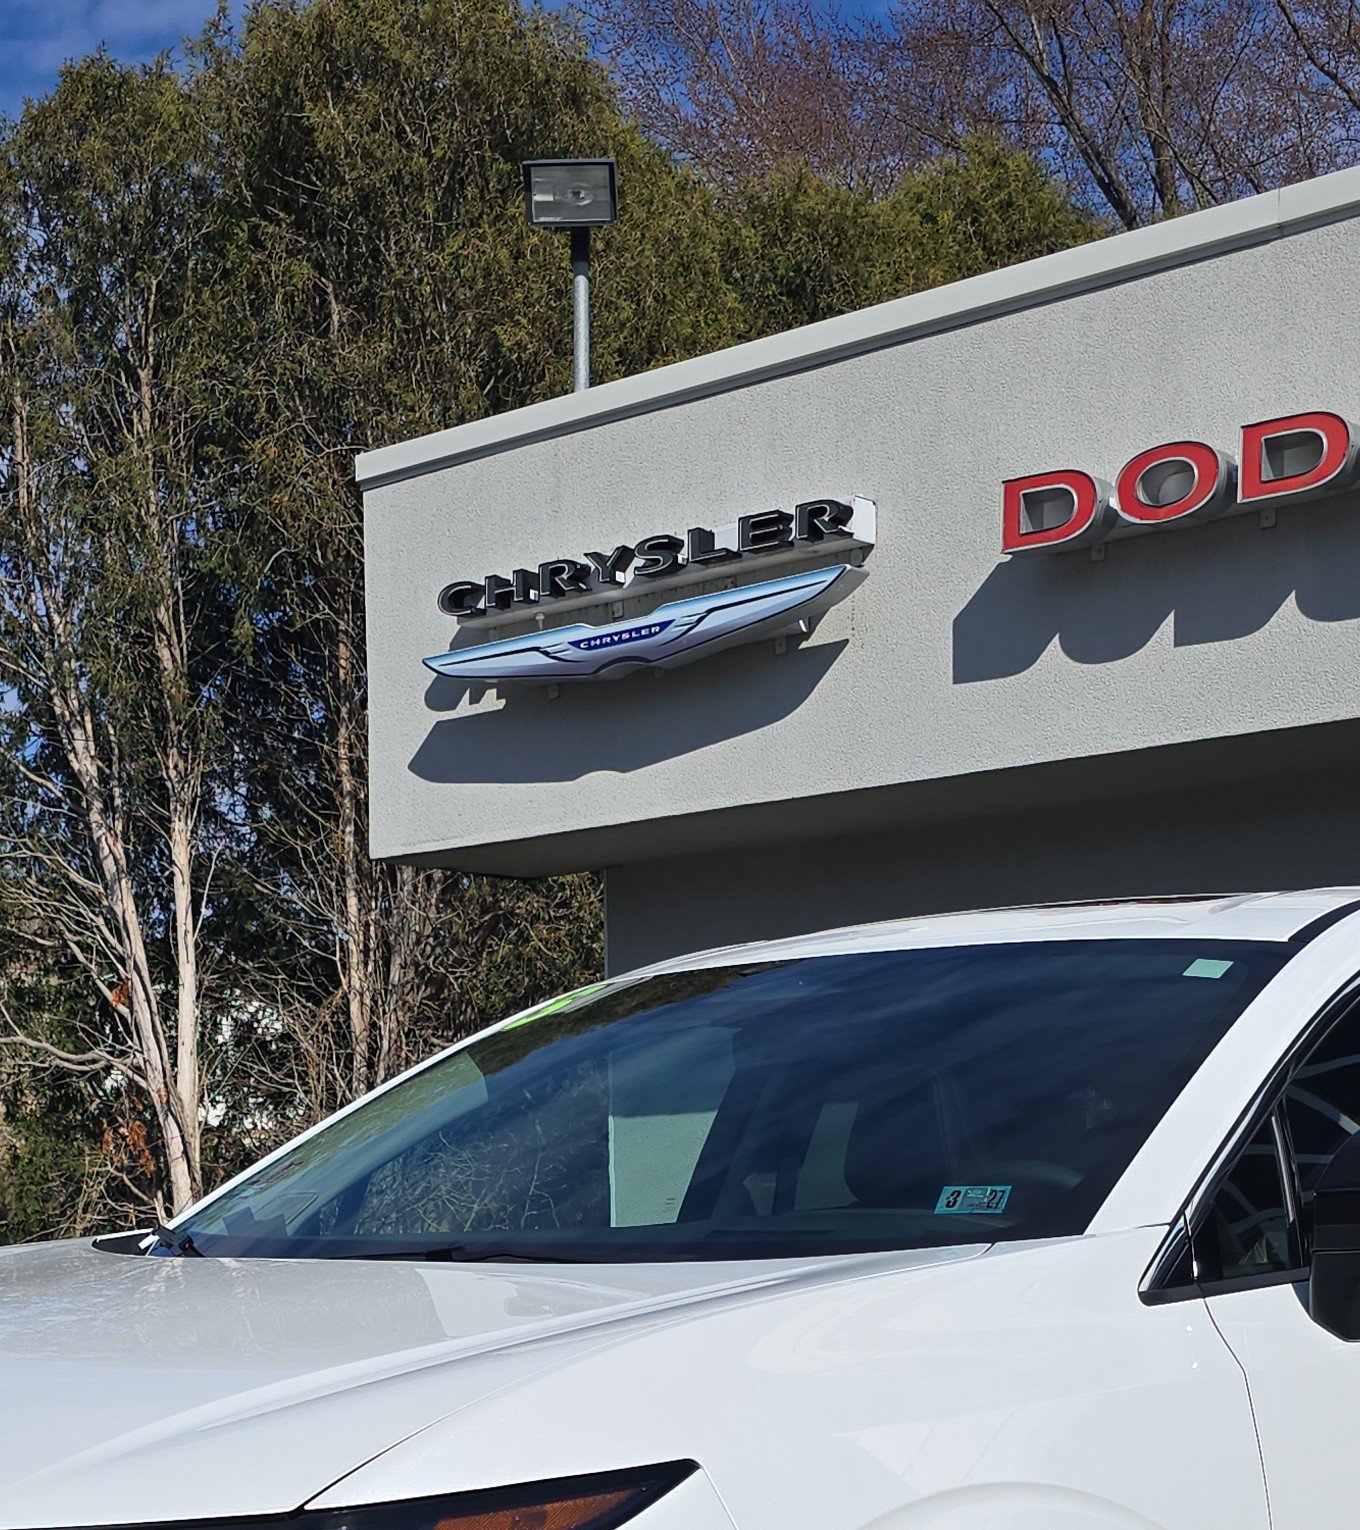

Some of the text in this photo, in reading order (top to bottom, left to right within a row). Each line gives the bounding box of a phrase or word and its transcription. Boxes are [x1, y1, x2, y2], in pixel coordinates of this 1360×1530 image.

[437, 499, 853, 616] CHRYSLER
[579, 626, 660, 649] CHRYSLER
[945, 1190, 961, 1208] 3
